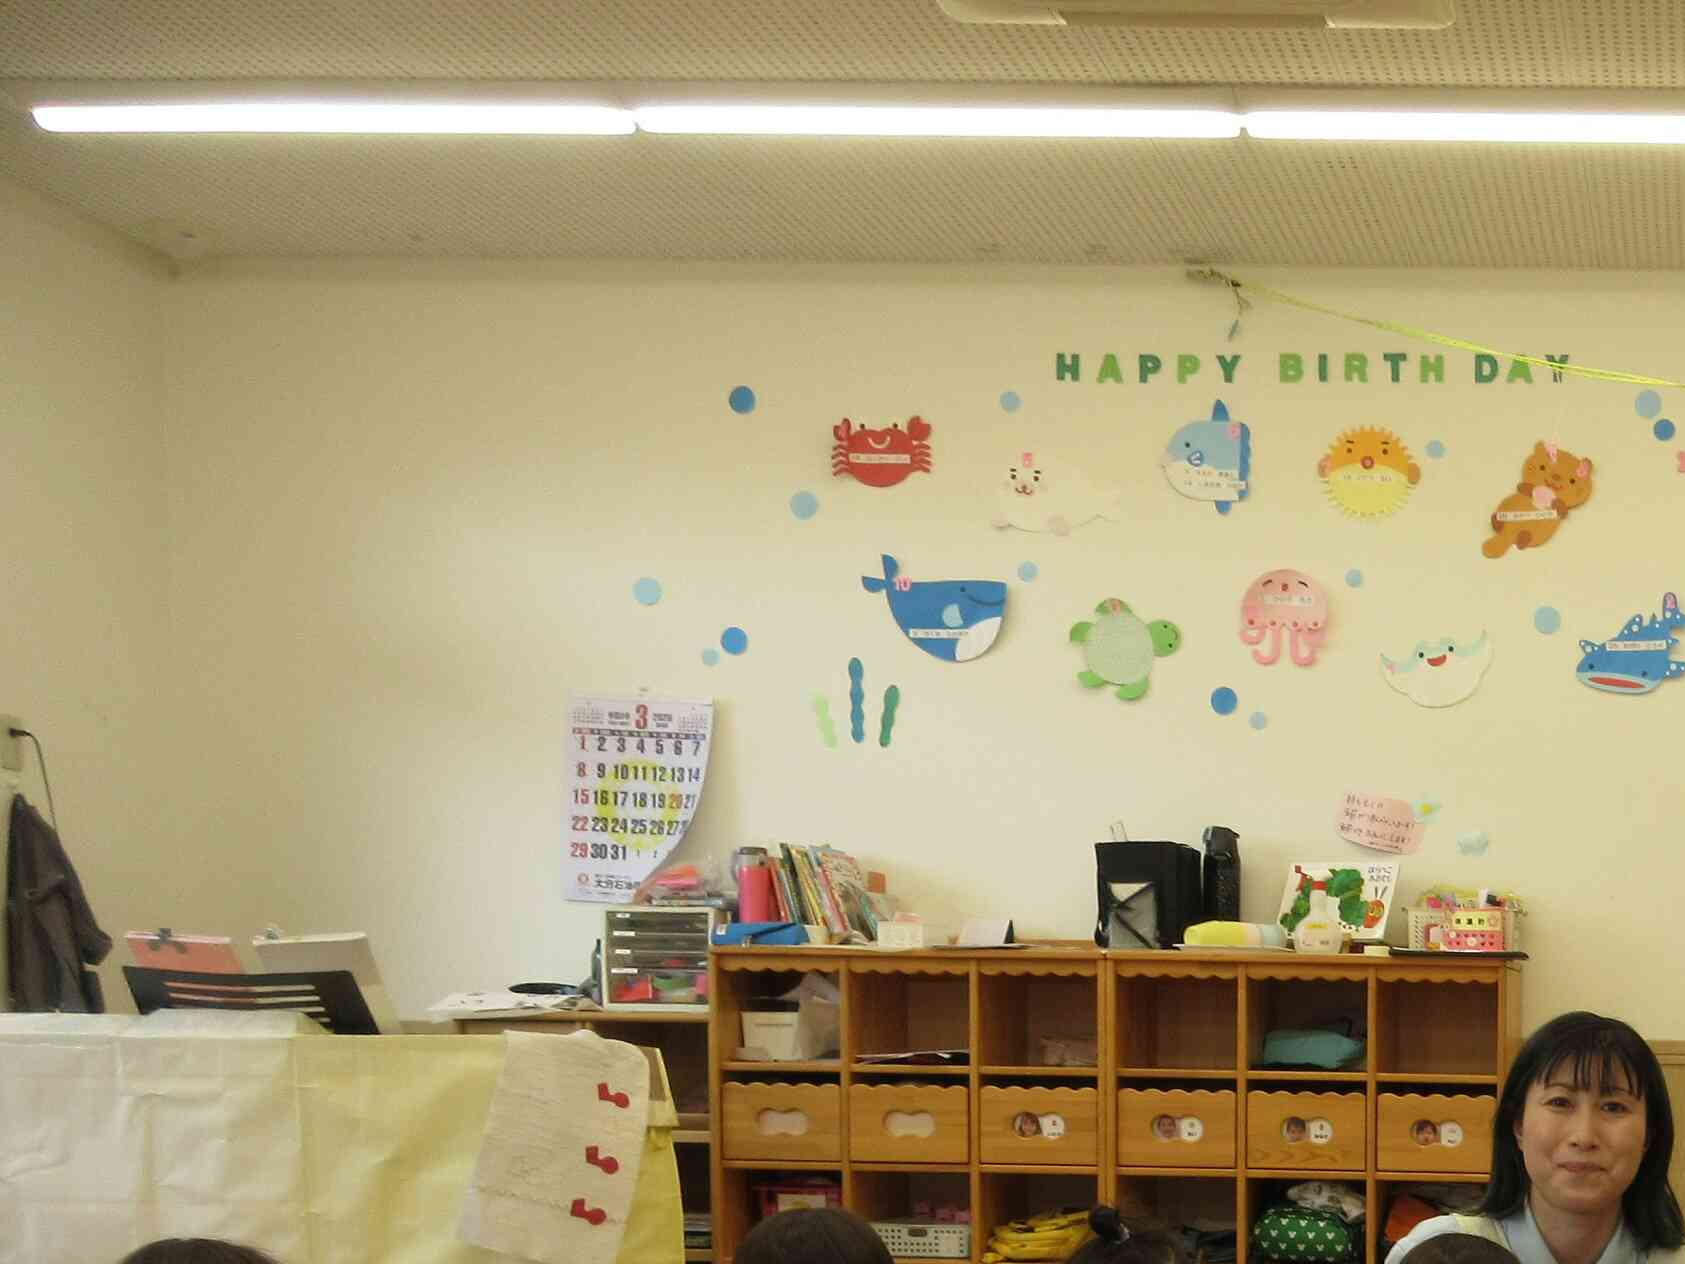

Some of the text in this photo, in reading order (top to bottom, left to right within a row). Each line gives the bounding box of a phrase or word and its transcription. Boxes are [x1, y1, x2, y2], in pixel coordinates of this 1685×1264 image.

[1055, 352, 1570, 384] HAPPY BIRTH DAY
[635, 704, 649, 729] 3
[579, 736, 700, 756] 1 2 3 4 5 6 7
[577, 762, 700, 783] 8 9 10 11 12 13 14
[574, 789, 589, 804] 15
[593, 790, 608, 806] 16
[613, 791, 628, 807] 17
[632, 792, 647, 808] 18
[651, 793, 666, 809] 19
[669, 793, 682, 809] 20
[571, 815, 588, 832] 22
[591, 816, 608, 833] 23
[611, 818, 627, 834] 24
[630, 819, 647, 835] 25
[650, 820, 665, 835] 26
[666, 821, 680, 836] 27
[570, 842, 588, 858] 29
[590, 843, 607, 859] 30
[610, 844, 627, 861] 31
